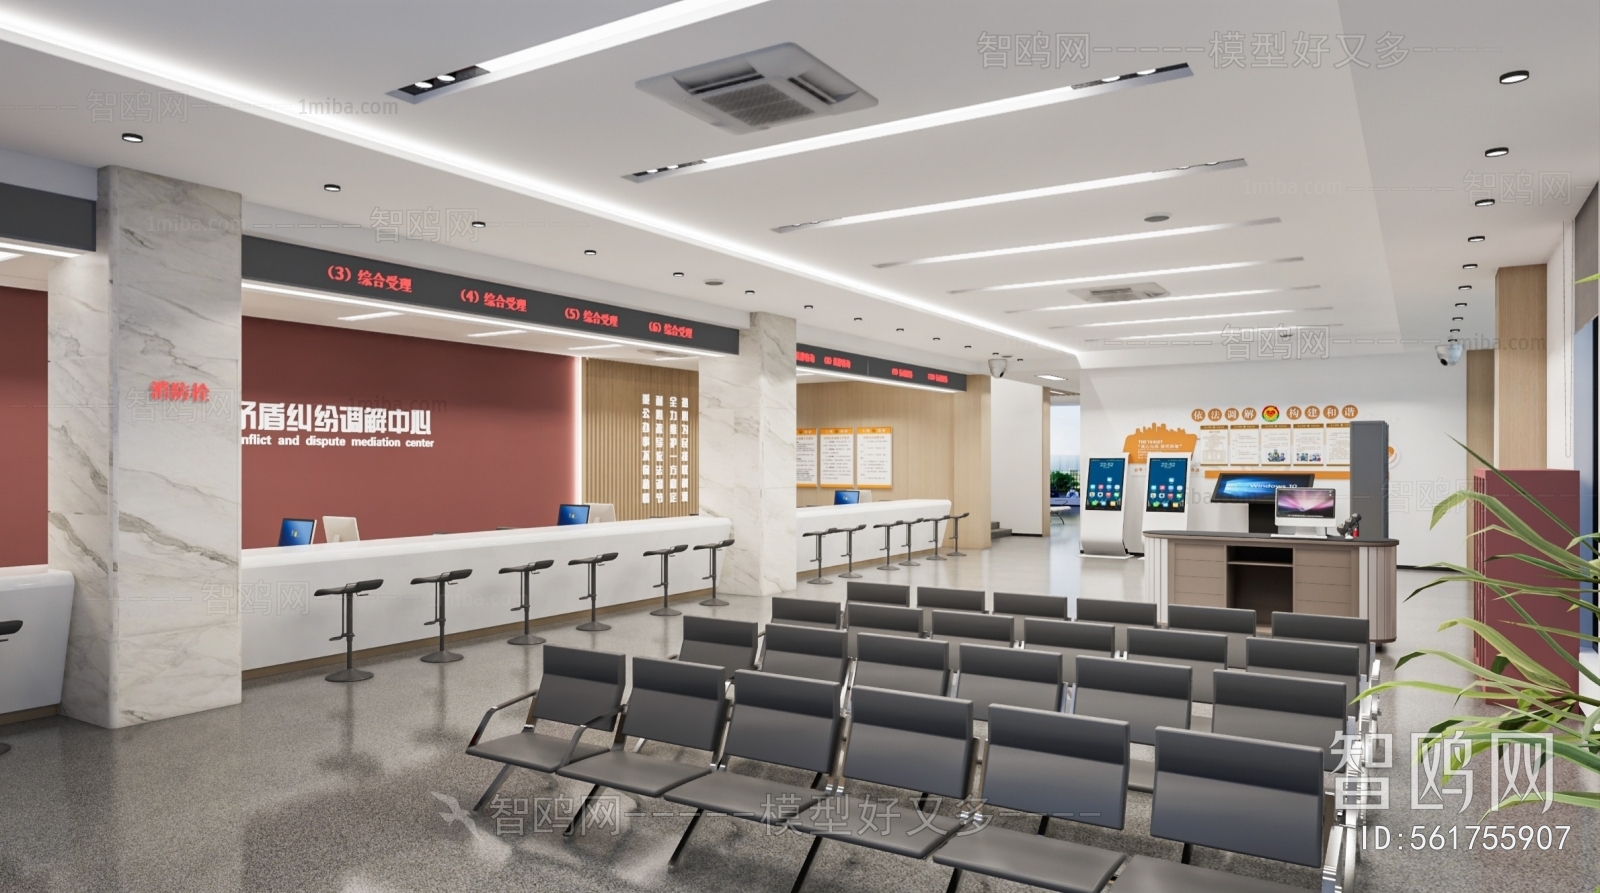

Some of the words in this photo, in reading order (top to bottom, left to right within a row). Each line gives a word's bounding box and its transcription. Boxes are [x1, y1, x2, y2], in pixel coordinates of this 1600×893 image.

[358, 270, 412, 293] 综合受理
[484, 292, 527, 312] 综合受理
[583, 310, 618, 327] 综合受理
[663, 323, 693, 338] 综合受理
[1192, 408, 1257, 422] 依法调解
[1286, 405, 1359, 420] 构建和谐
[241, 434, 272, 446] nflict
[278, 435, 300, 446] and
[306, 436, 346, 448] dispute
[352, 437, 401, 447] mediation
[405, 439, 435, 448] center
